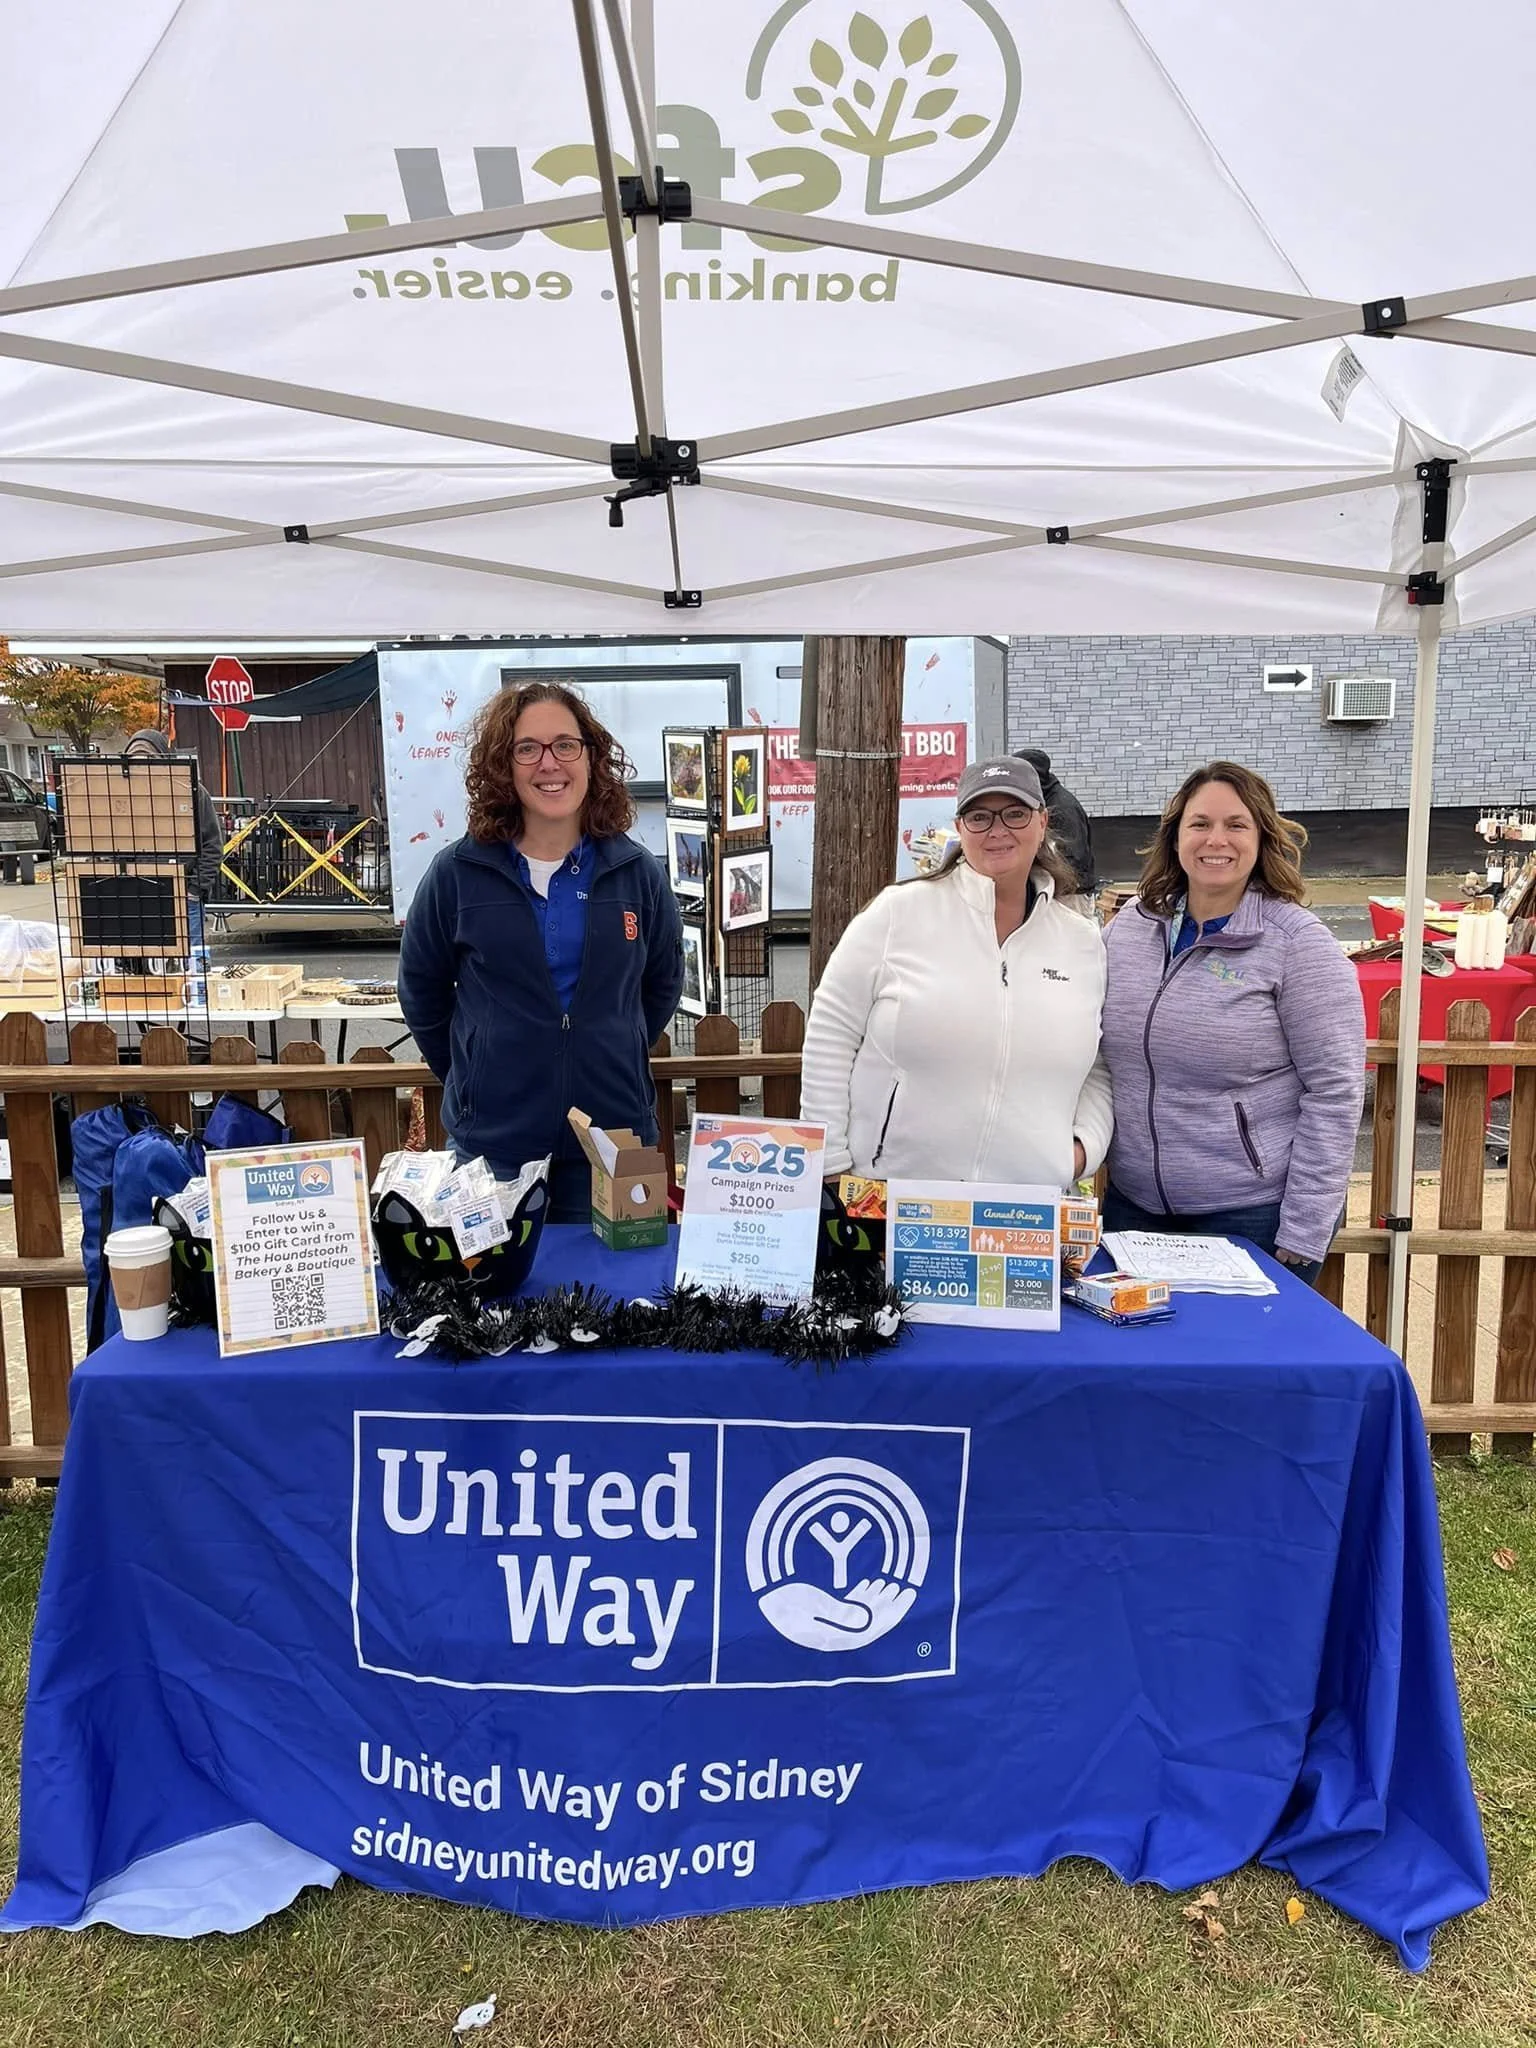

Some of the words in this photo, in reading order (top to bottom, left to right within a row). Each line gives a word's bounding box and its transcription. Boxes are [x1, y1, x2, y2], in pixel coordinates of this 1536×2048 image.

[210, 680, 250, 704] STOP
[436, 731, 457, 742] ONE
[916, 730, 956, 757] BBQ
[767, 784, 782, 795] OOK
[782, 805, 809, 816] KEEP
[248, 1167, 295, 1186] United
[711, 1176, 762, 1191] Campaign
[764, 1181, 795, 1193] Prizes
[266, 1182, 296, 1198] Way
[729, 1193, 775, 1210] $1000
[252, 1214, 295, 1226] Follow
[298, 1210, 315, 1221] Us
[318, 1208, 328, 1219] &
[983, 1208, 1015, 1219] Annual
[1015, 1210, 1044, 1224] Recap
[246, 1228, 281, 1240] Enter
[284, 1224, 298, 1235] to
[301, 1222, 325, 1233] win
[327, 1221, 336, 1231] a
[733, 1220, 766, 1235] $500
[923, 1226, 968, 1239] $18,392
[230, 1241, 261, 1255] $100
[264, 1238, 288, 1250] Gift
[290, 1234, 321, 1248] Card
[324, 1231, 355, 1243] from
[1006, 1231, 1051, 1244] $12,700
[236, 1255, 261, 1267] The
[264, 1243, 348, 1263] Houndstooth
[730, 1250, 760, 1265] $250
[234, 1265, 281, 1281] Bakery
[284, 1263, 295, 1275] &
[297, 1255, 357, 1275] Boutique
[902, 1278, 969, 1299] $86,000
[1014, 1279, 1042, 1289] $3,000
[376, 1447, 698, 1541] United
[496, 1553, 695, 1671] Way
[359, 1741, 501, 1811] United
[517, 1766, 622, 1831] Way
[636, 1761, 687, 1812] of
[699, 1757, 863, 1805] Sidney
[350, 1815, 756, 1891] sidneyunitedway.org
